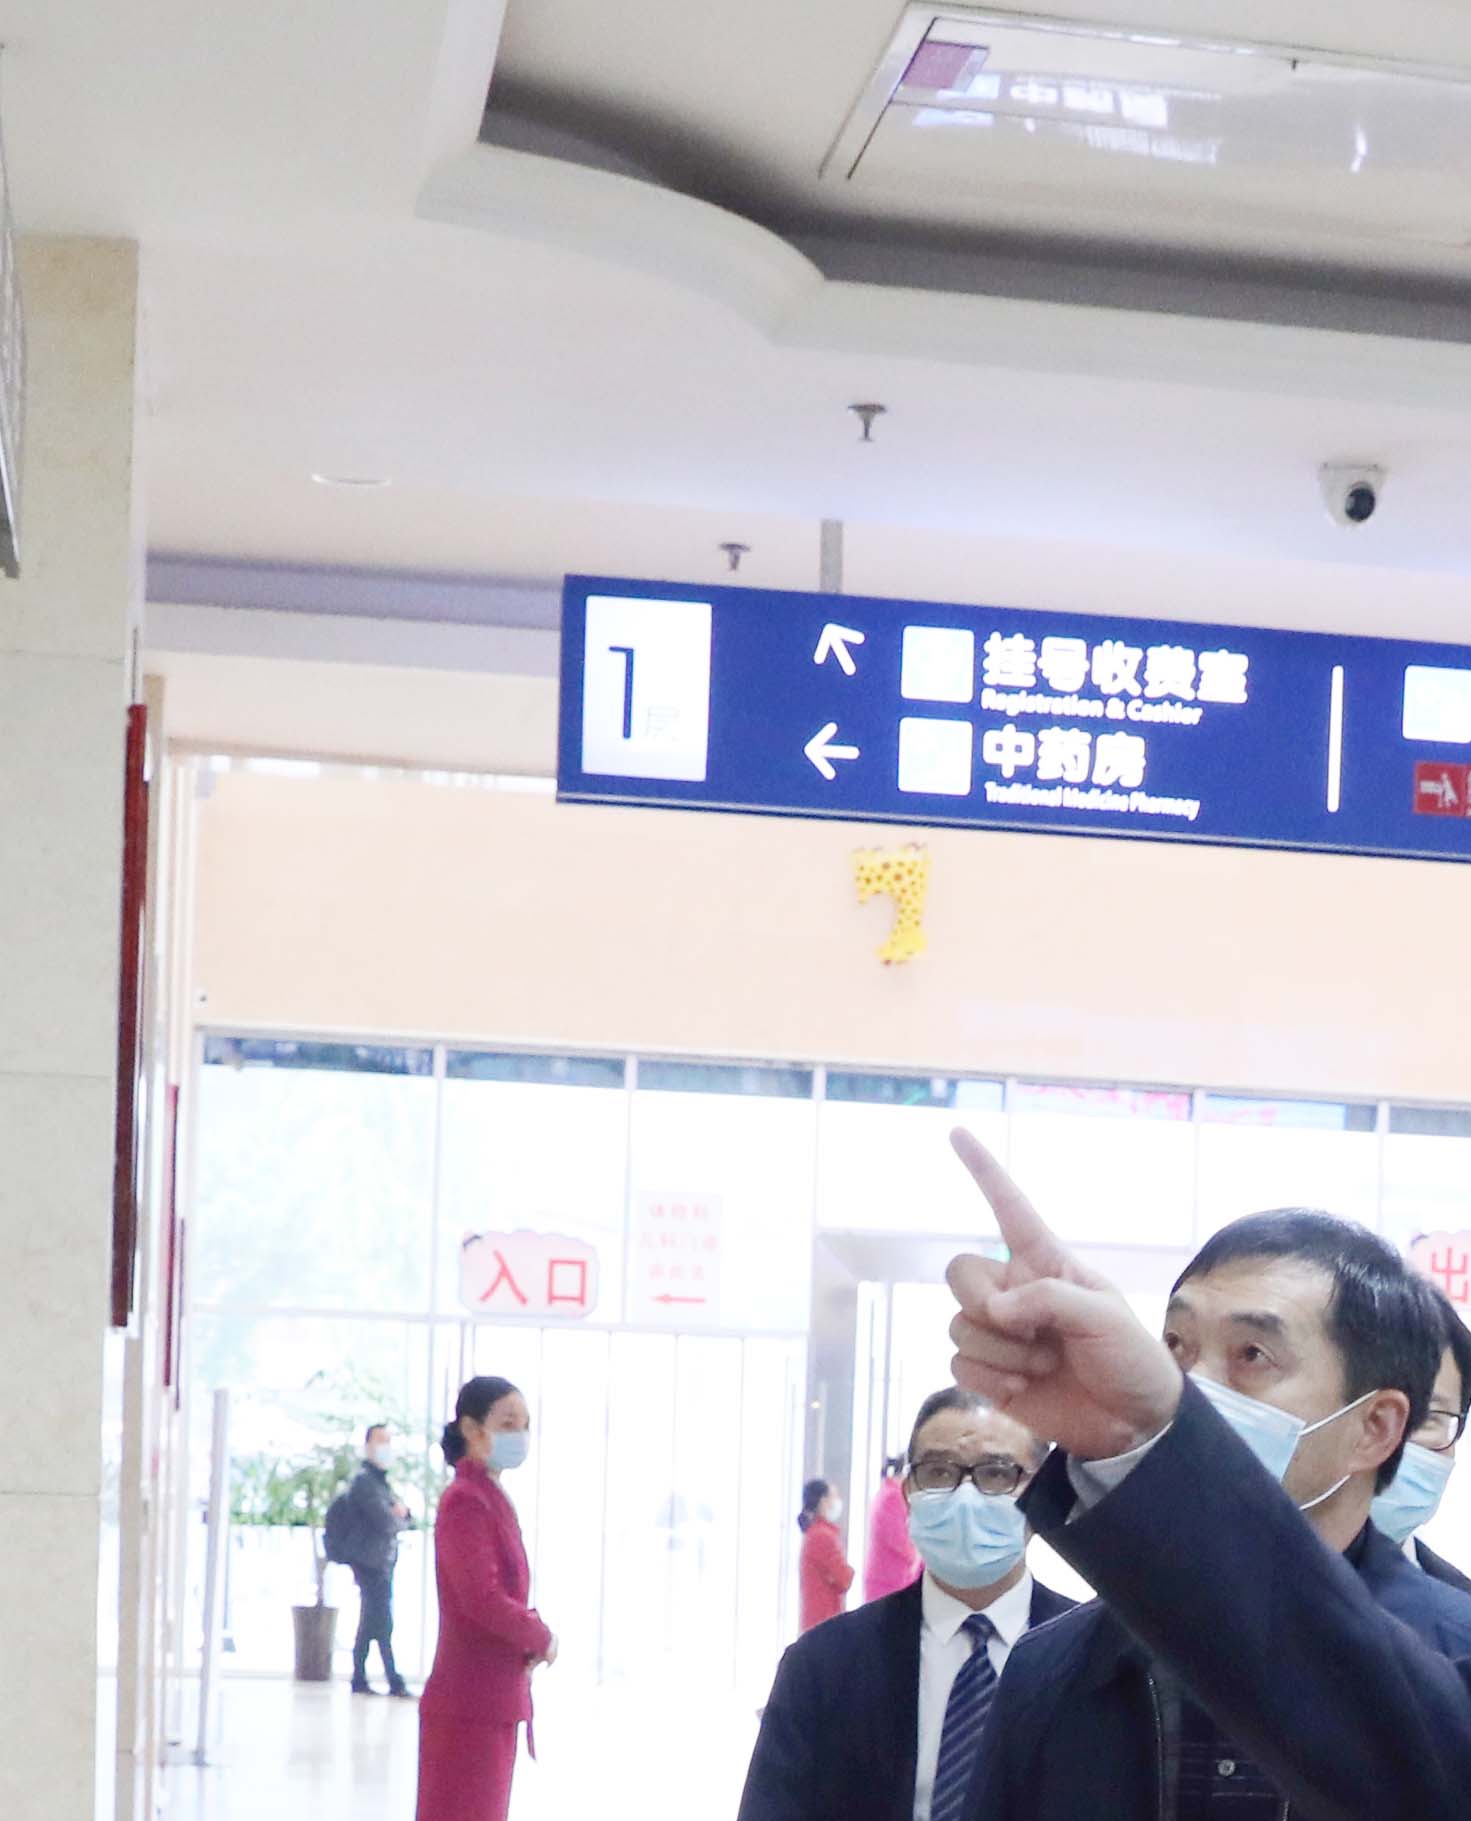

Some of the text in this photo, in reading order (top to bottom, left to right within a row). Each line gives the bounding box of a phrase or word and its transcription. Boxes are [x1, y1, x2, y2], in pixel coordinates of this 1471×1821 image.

[982, 631, 1249, 704] 挂号收费室
[980, 688, 1204, 726] Registration & Cashier
[982, 723, 1147, 788] 中药房
[478, 1249, 587, 1306] 入口
